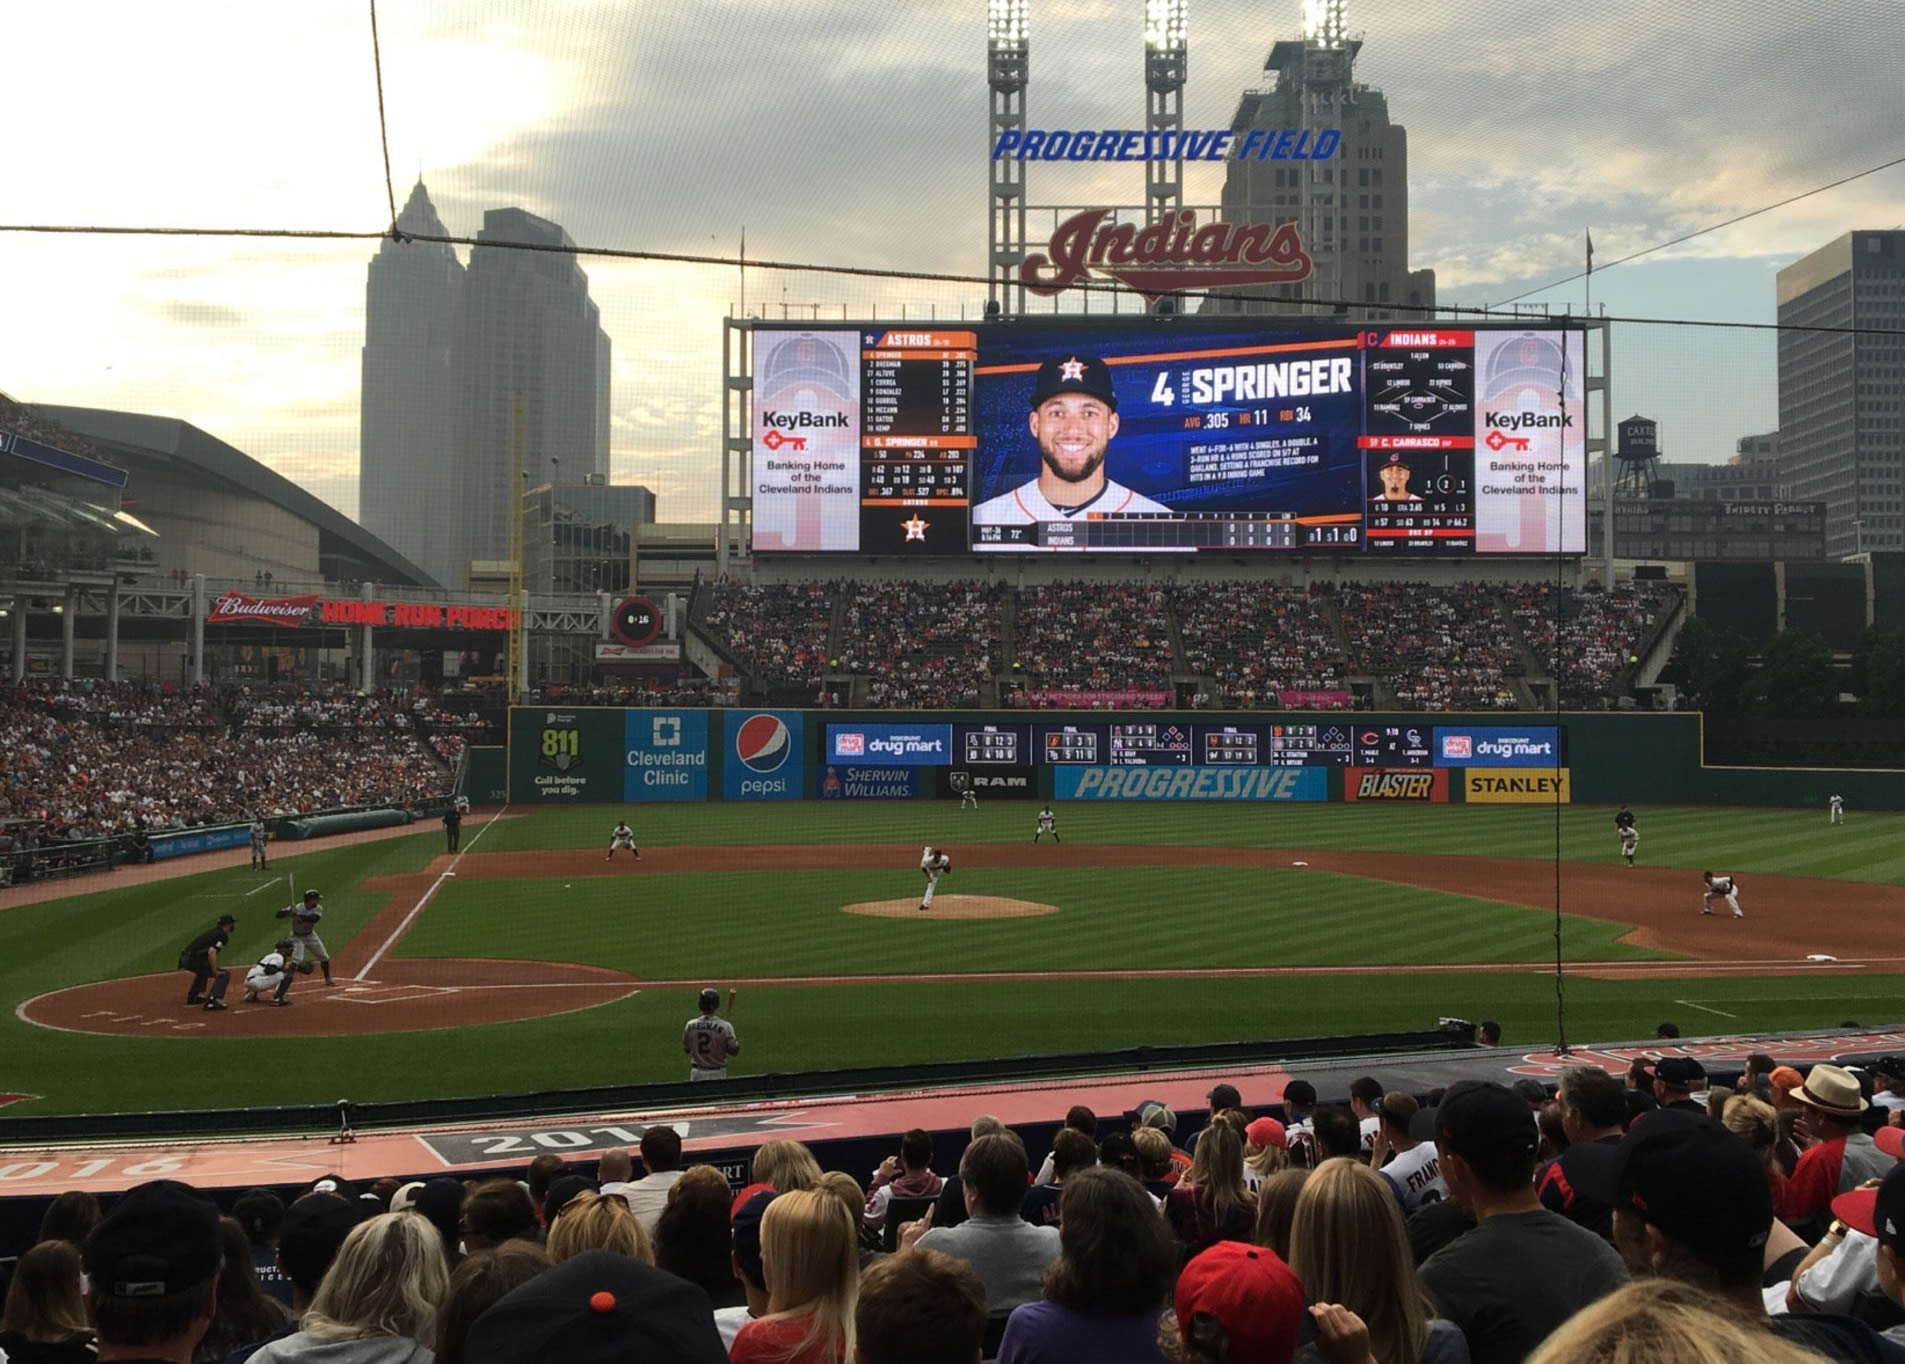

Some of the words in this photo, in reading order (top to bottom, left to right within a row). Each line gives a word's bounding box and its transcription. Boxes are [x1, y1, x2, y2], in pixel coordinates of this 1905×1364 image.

[992, 129, 1232, 161] PROGRESSIVE
[1238, 129, 1341, 160] FIELD
[1020, 209, 1312, 303] Indians
[887, 334, 931, 345] ASTROS
[1390, 334, 1437, 345] INDIANS
[1151, 372, 1175, 406] 4
[1181, 371, 1190, 405] GEORGE
[1192, 358, 1352, 404] SPRINGER
[763, 411, 848, 430] KeyBank
[1184, 416, 1200, 429] AVG
[1203, 413, 1229, 430] .305
[1239, 413, 1251, 424] HR
[1254, 409, 1268, 425] 11
[1279, 409, 1294, 421] RBI
[1296, 406, 1311, 422] 34
[1485, 412, 1573, 431] KeyBank
[1292, 447, 1300, 456] AT
[767, 461, 811, 472] Banking
[814, 461, 845, 470] Home
[1250, 457, 1281, 468] FRANCHISE
[1283, 456, 1306, 465] RECORD
[1307, 455, 1319, 464] FOR
[1490, 462, 1534, 473] Banking
[1538, 462, 1570, 471] Home
[791, 473, 802, 482] of
[804, 473, 821, 482] the
[1248, 468, 1265, 477] GAME
[1514, 474, 1526, 483] of
[1528, 474, 1545, 483] the
[759, 485, 811, 494] Cleveland
[814, 485, 853, 494] Indians
[1482, 485, 1535, 495] Cleveland
[1539, 485, 1578, 495] Indians
[1047, 523, 1073, 532] ASTROS
[1047, 536, 1074, 545] INDIANS
[1316, 527, 1321, 542] 1
[1327, 533, 1332, 542] S
[1333, 527, 1338, 542] 1
[1349, 527, 1357, 542] 0
[216, 595, 309, 616] Budweiser
[322, 600, 388, 625] HOME
[395, 604, 440, 627] RUN
[542, 729, 578, 756] 811
[869, 739, 904, 755] drug
[906, 739, 942, 752] mart
[995, 736, 1004, 746] 12
[1007, 736, 1012, 746] 3
[1077, 736, 1083, 746] 3
[1065, 750, 1071, 759] 5
[1075, 750, 1084, 760] 11
[1477, 741, 1512, 758] drug
[1514, 742, 1551, 754] mart
[627, 750, 705, 766] Cleveland
[534, 776, 552, 784] Call
[554, 776, 587, 784] before
[643, 770, 688, 785] Clinic
[846, 768, 910, 782] SHERWIN
[974, 777, 1027, 786] RAM
[740, 779, 786, 795] pepsi
[1074, 768, 1301, 798] PROGRESSIVE
[1471, 778, 1563, 793] STANLEY
[541, 786, 560, 795] you
[561, 785, 580, 796] dig.
[698, 1032, 710, 1054] 2
